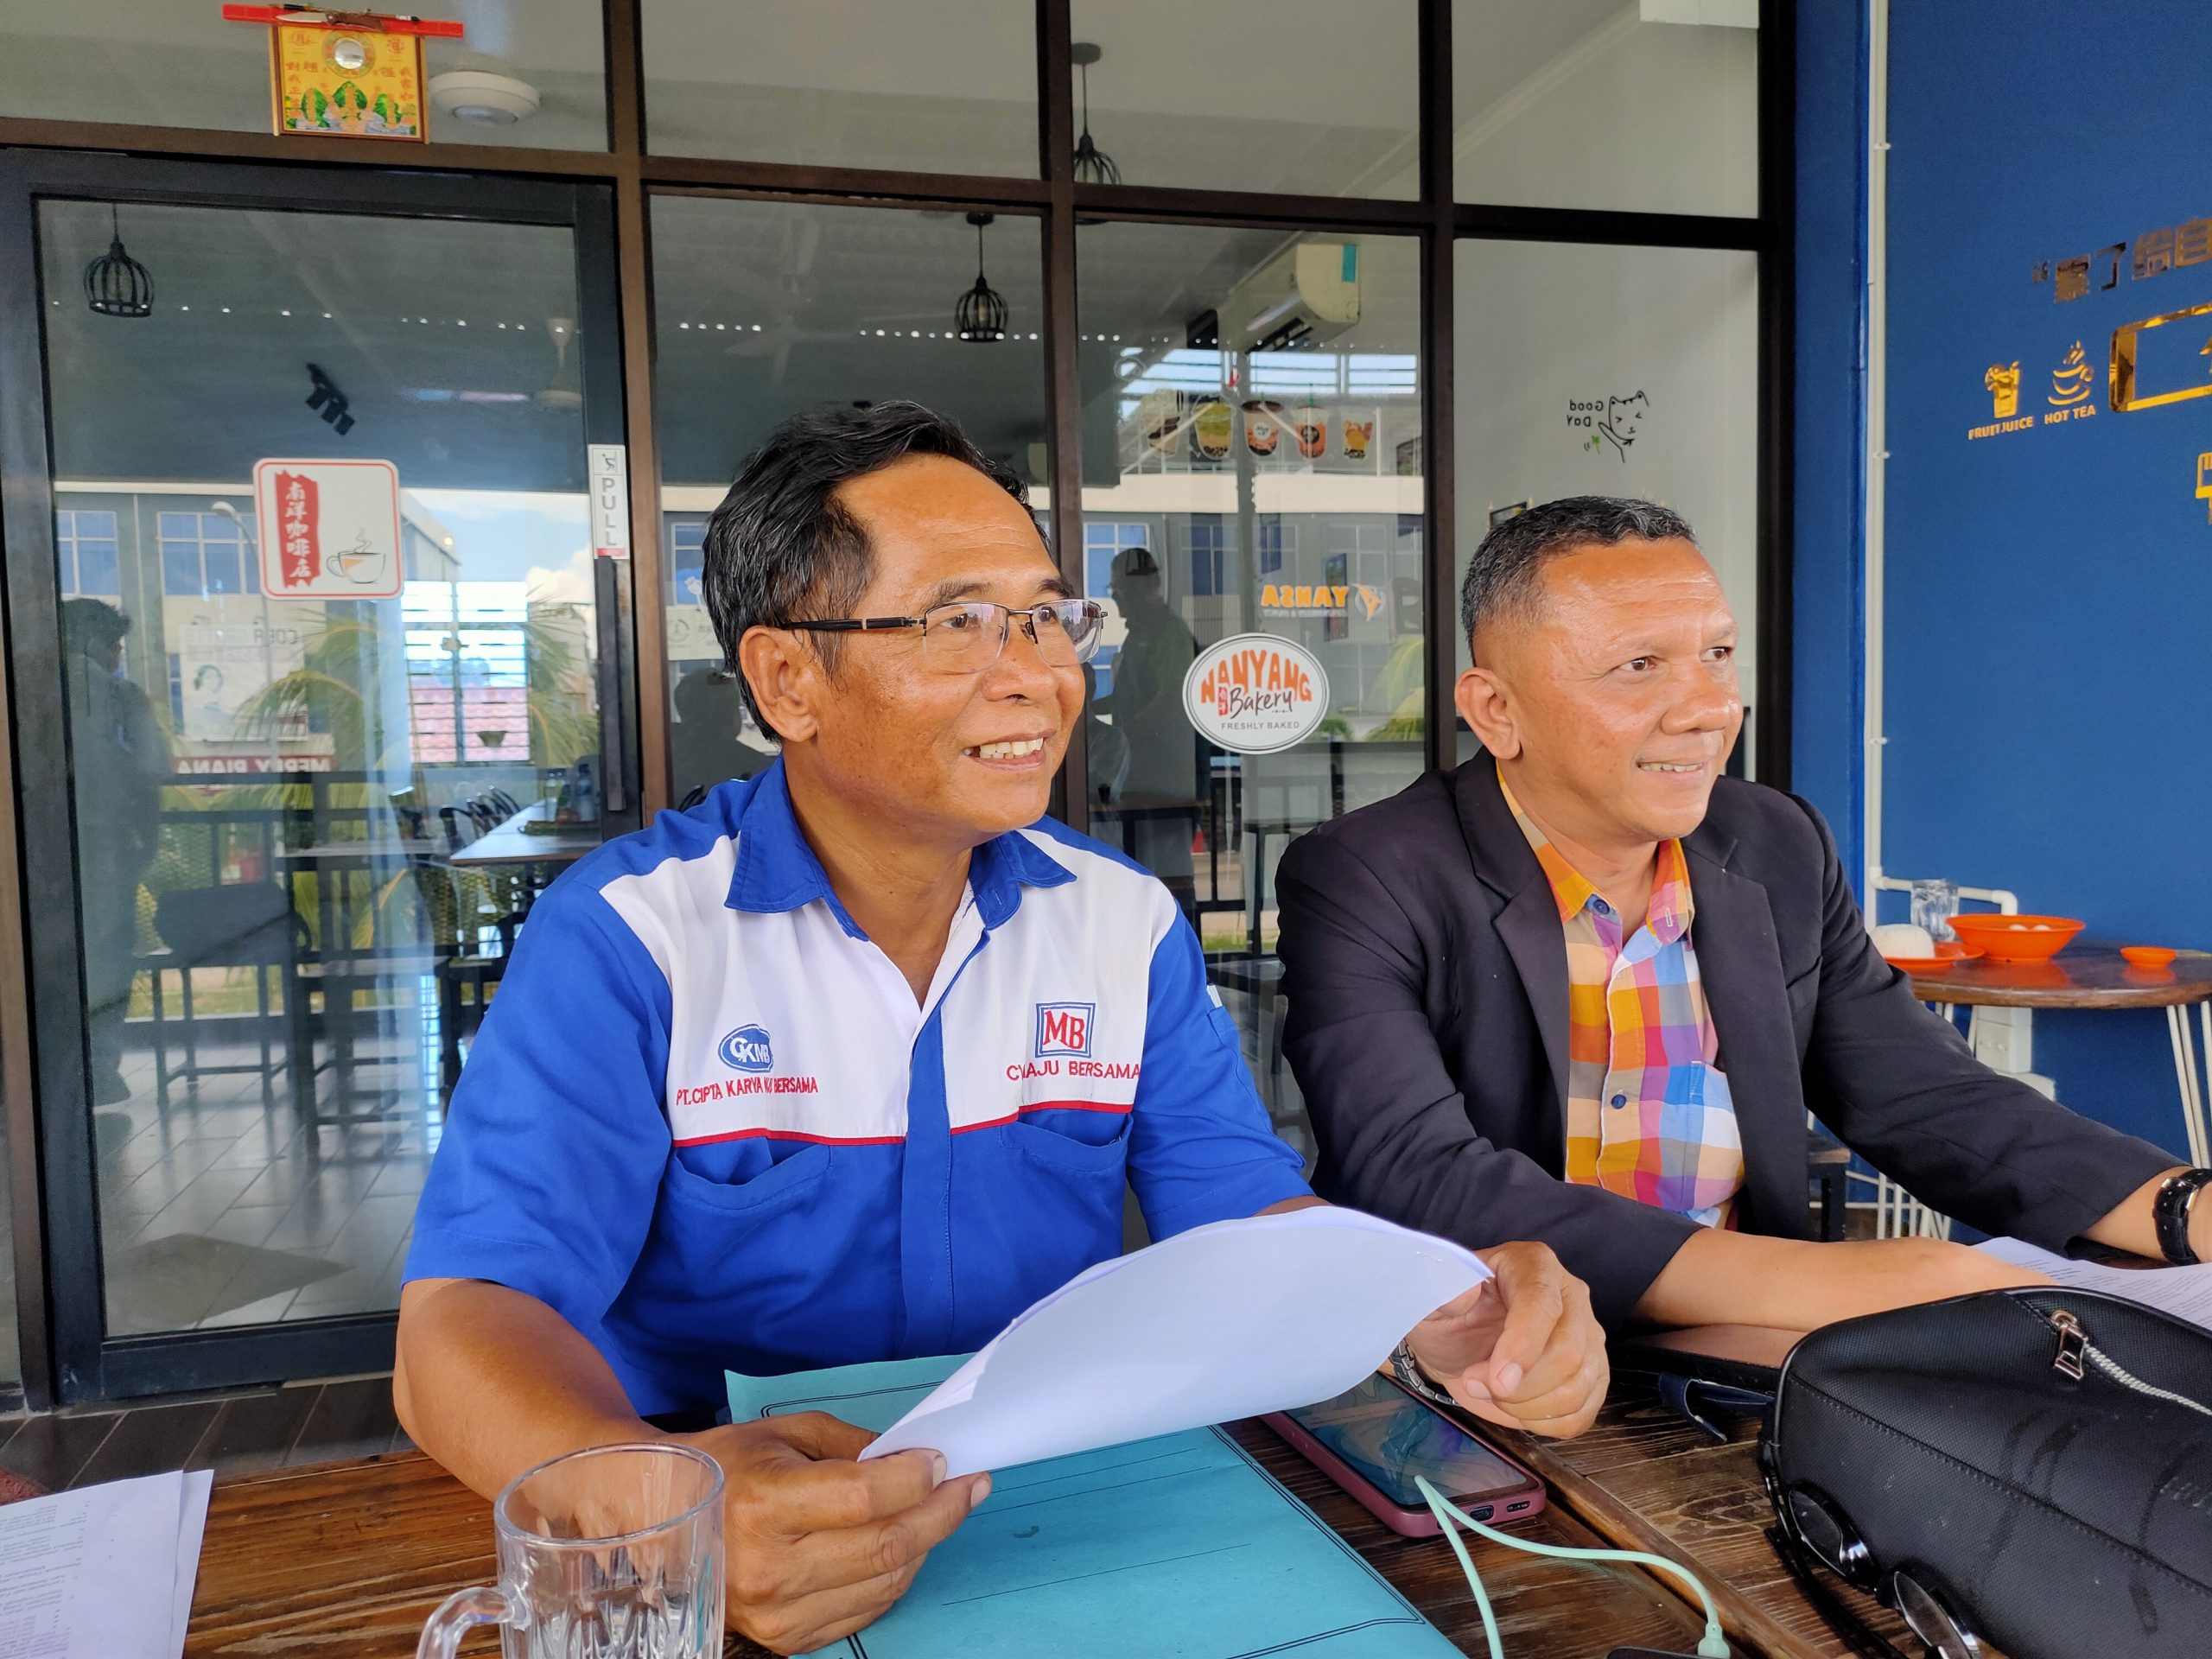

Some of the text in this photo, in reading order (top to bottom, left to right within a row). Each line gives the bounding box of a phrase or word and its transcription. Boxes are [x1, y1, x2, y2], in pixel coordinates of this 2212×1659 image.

[1968, 416, 2034, 441] FRUIT JUICE
[2044, 404, 2096, 425] HOT TEA
[601, 477, 618, 546] PULL
[284, 480, 312, 578] 南洋咖啡店
[1200, 650, 1313, 704] NANYANG
[1230, 687, 1294, 719] Bakery
[1221, 721, 1264, 730] FRESHLY
[1043, 1010, 1086, 1050] MB
[1069, 1061, 1141, 1079] BERSAMA
[725, 1077, 763, 1097] KARYA
